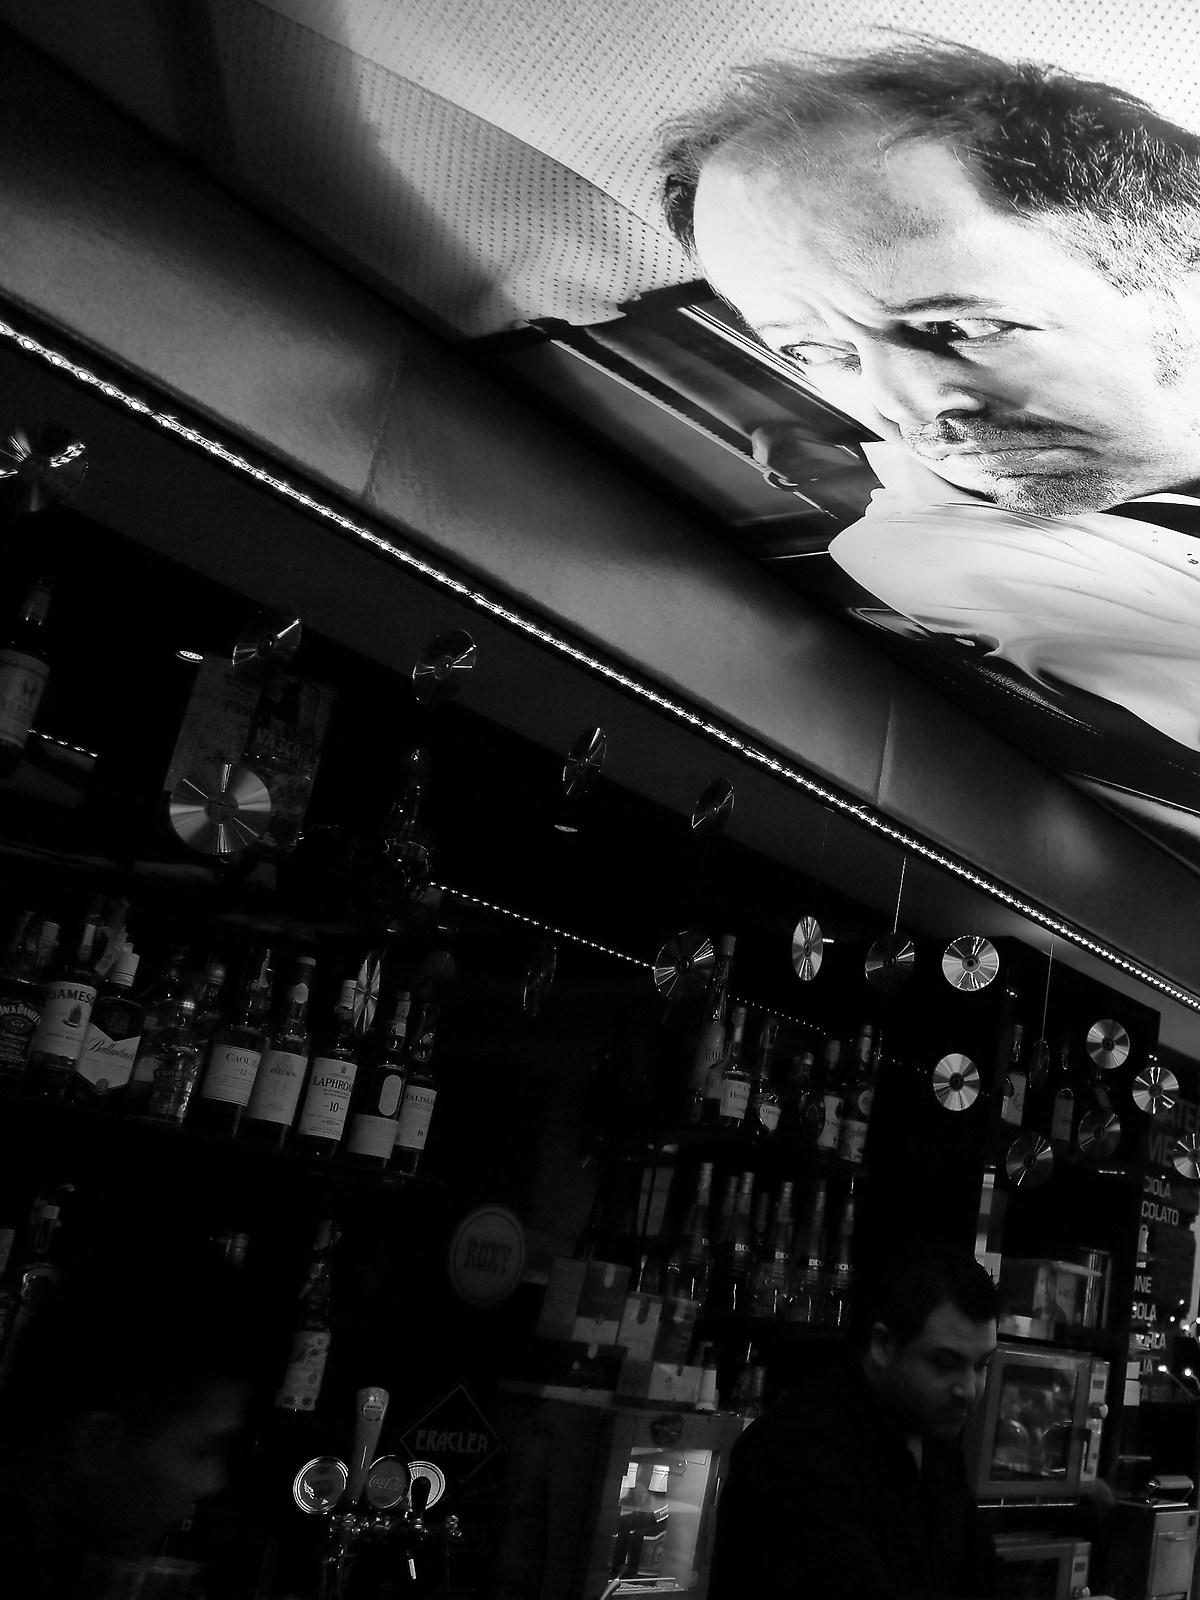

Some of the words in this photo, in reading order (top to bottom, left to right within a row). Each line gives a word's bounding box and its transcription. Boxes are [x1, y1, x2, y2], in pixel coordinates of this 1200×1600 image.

[329, 1101, 339, 1113] 10
[1141, 1200, 1179, 1226] COLATO
[463, 1236, 513, 1276] ROXY
[415, 1429, 489, 1454] ERACLEA
